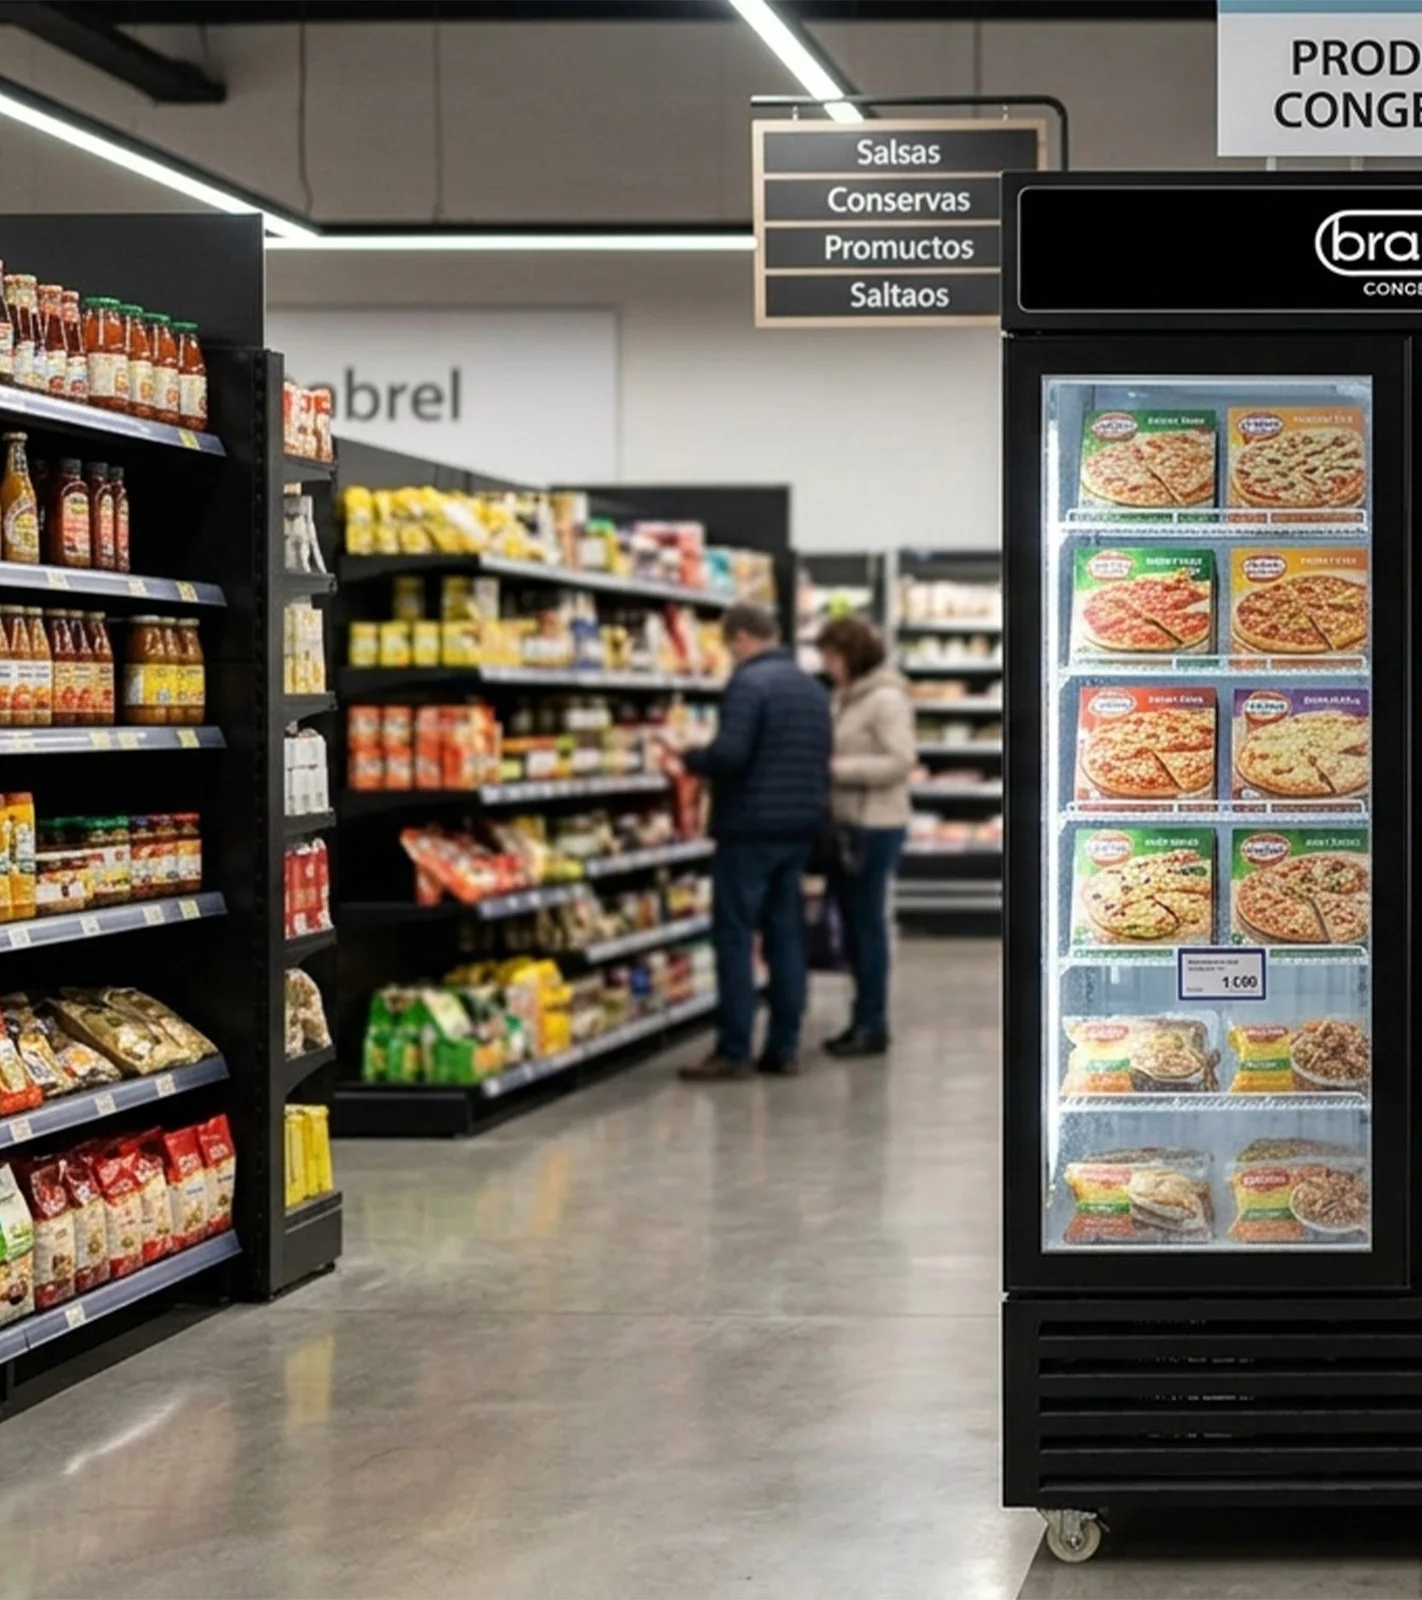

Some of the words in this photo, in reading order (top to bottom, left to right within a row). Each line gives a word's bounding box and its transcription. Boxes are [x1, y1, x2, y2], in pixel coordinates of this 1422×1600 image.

[856, 138, 941, 165] Salsas
[827, 186, 971, 213] Conservas
[824, 234, 975, 261] Promuctos
[850, 281, 950, 308] Saltaos
